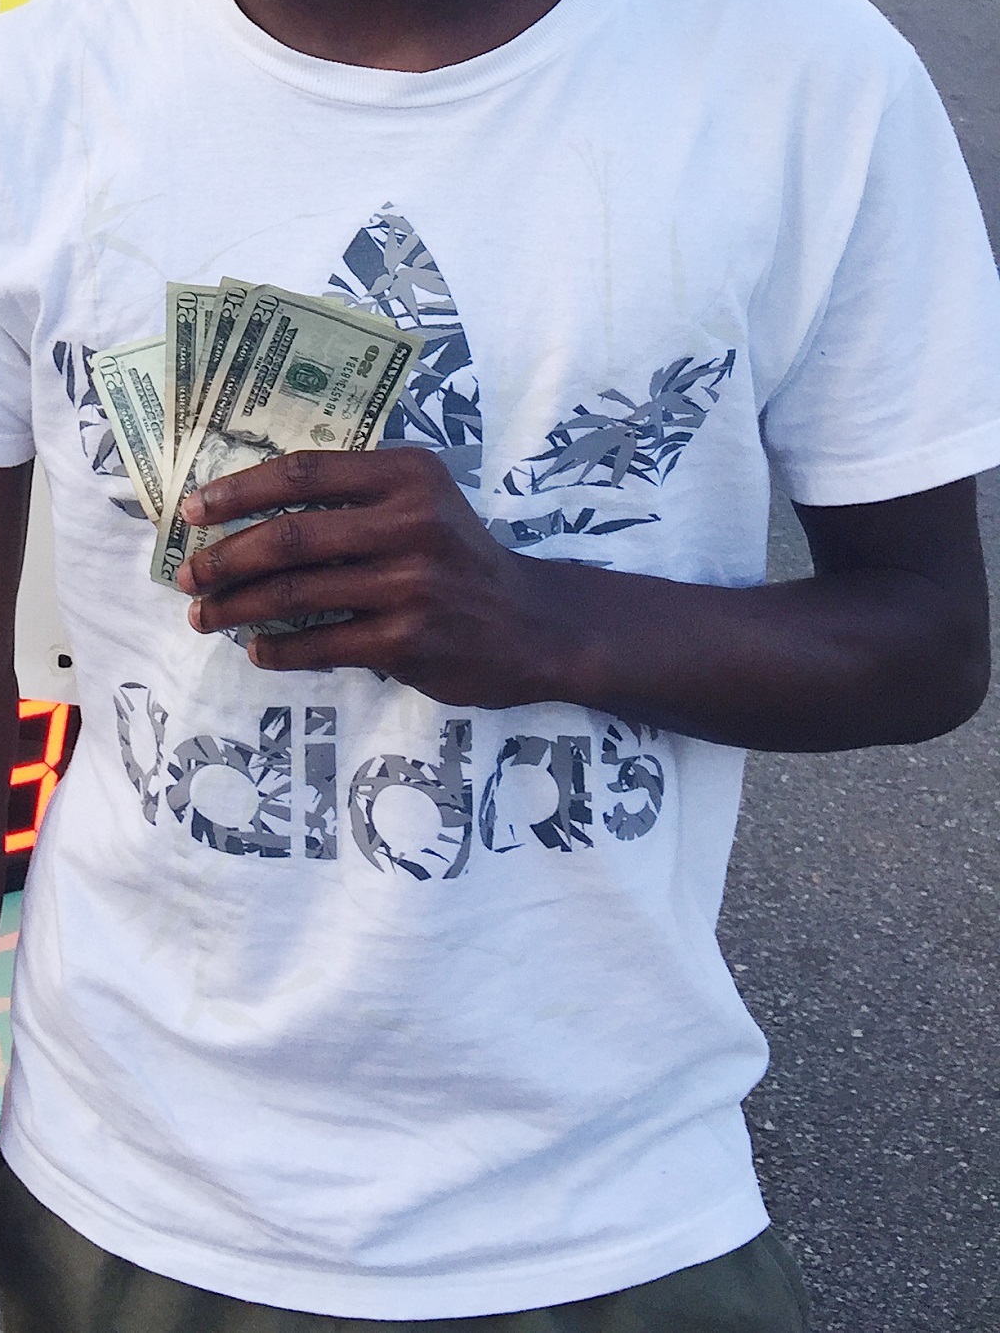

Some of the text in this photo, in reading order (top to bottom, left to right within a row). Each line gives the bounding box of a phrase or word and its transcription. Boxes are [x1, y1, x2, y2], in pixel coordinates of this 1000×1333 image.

[176, 290, 199, 325] 20
[219, 284, 248, 320] 20
[249, 289, 281, 327] 20
[95, 352, 124, 392] 20
[355, 342, 381, 379] 20
[368, 346, 408, 413] DOLLARS
